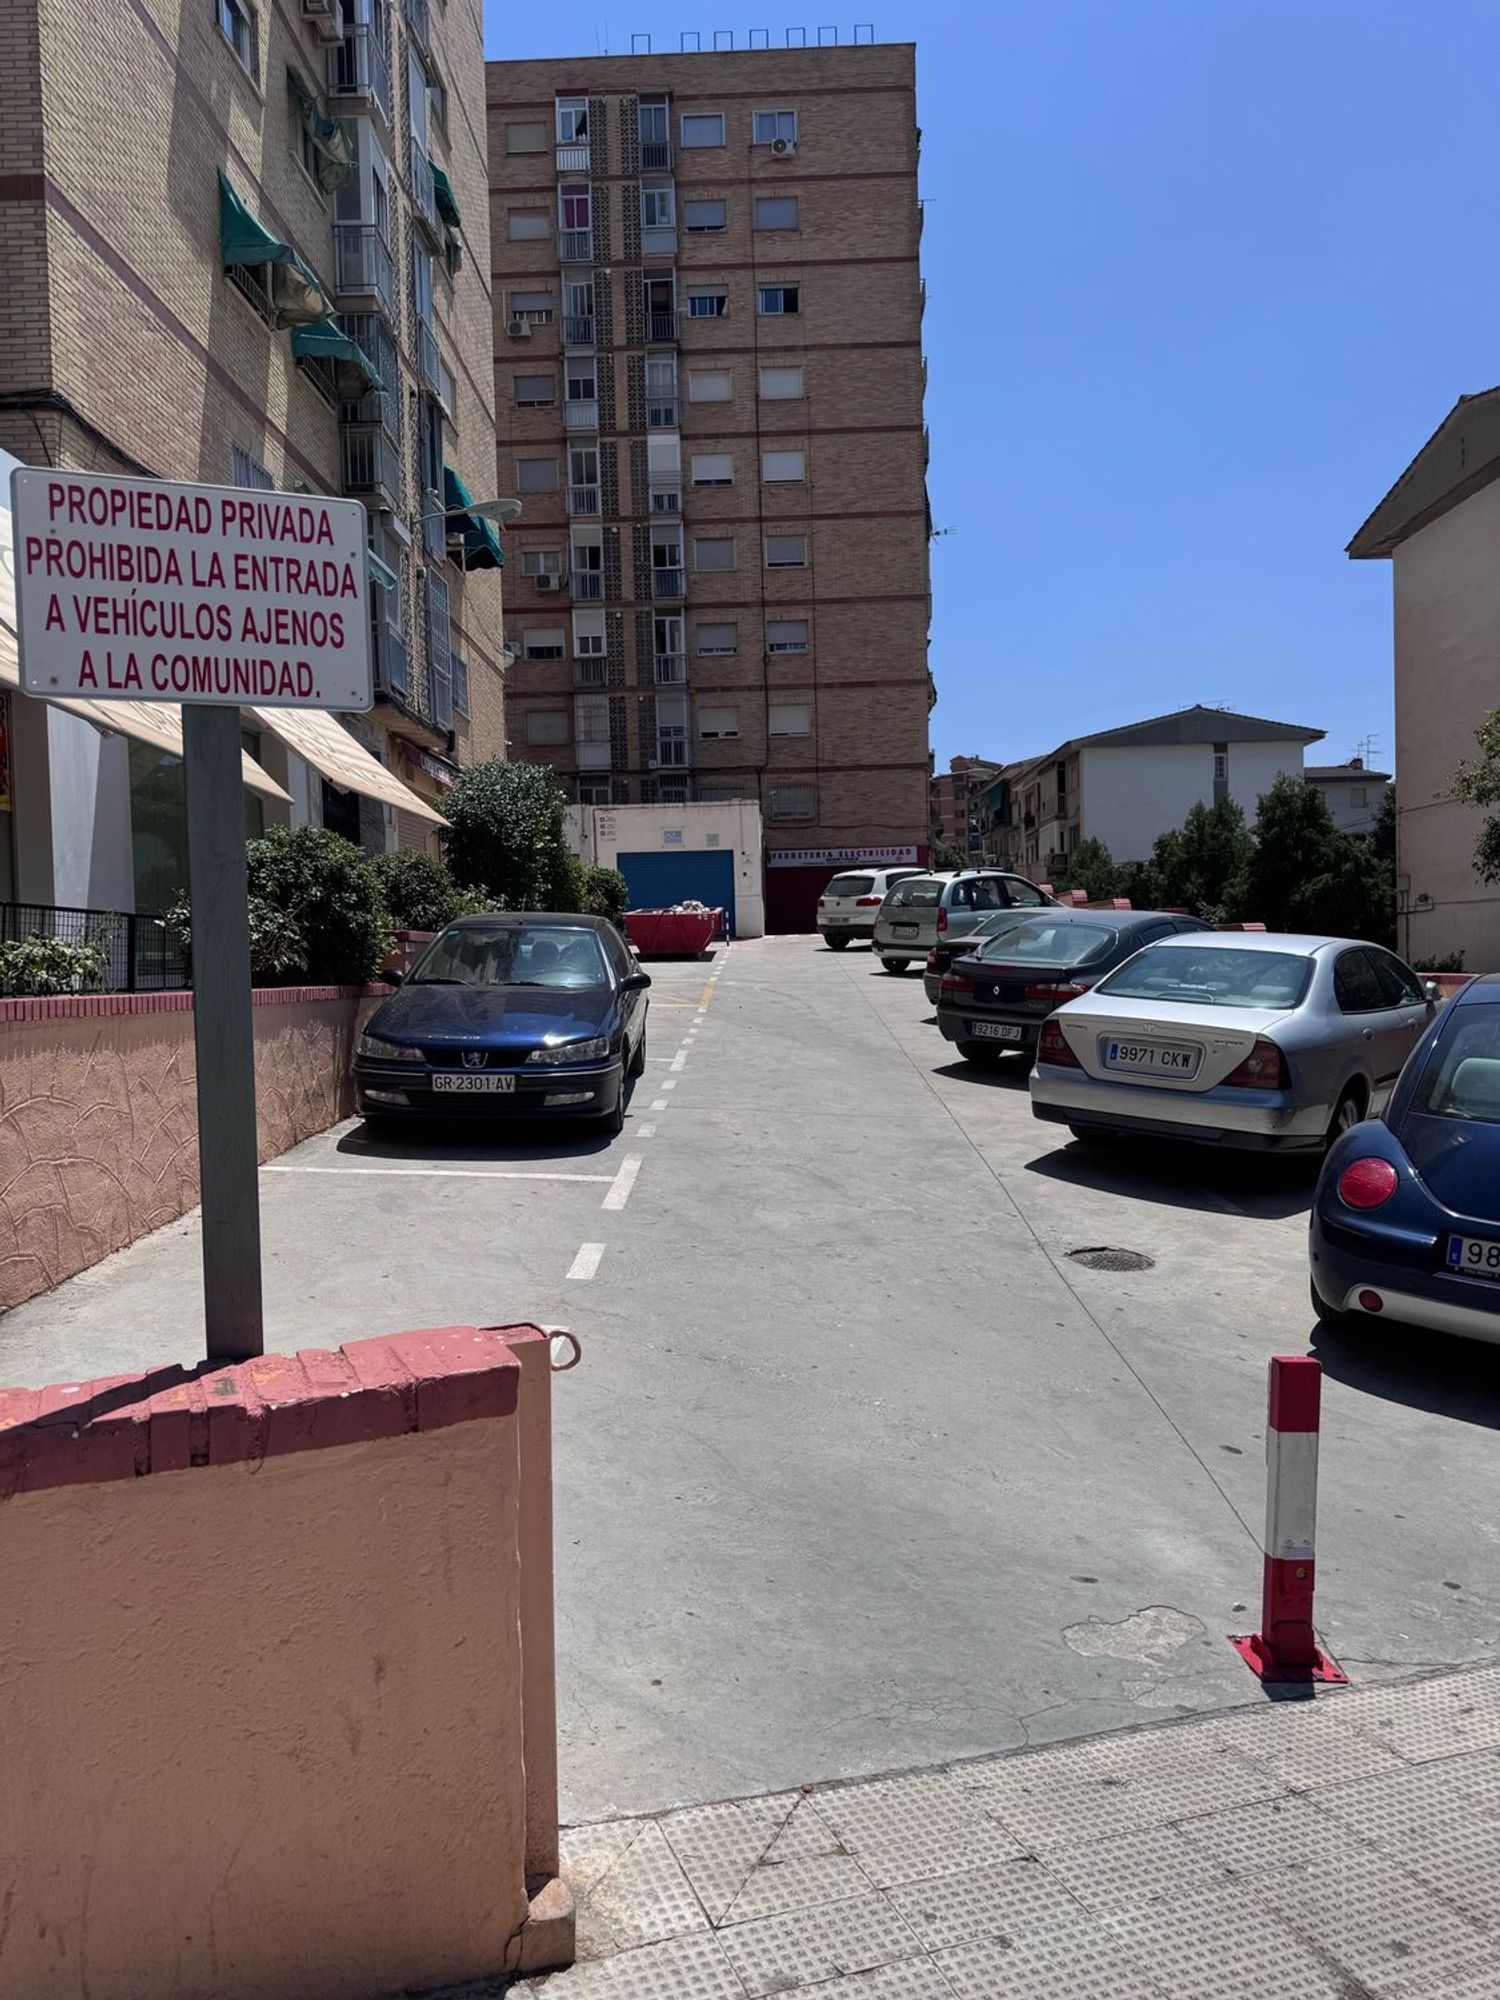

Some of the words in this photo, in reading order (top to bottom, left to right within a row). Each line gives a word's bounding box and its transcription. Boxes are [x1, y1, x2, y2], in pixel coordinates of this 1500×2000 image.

[48, 483, 212, 535] PROPIEDAD
[222, 499, 334, 546] PRIVADA
[26, 537, 182, 586] PROHIBIDA
[191, 550, 226, 589] LA
[234, 553, 358, 599] ENTRADA
[45, 593, 66, 632] A
[73, 588, 232, 642] VEHÍCULOS
[241, 606, 345, 649] AJENOS
[78, 651, 98, 688] A
[107, 652, 143, 690] LA
[151, 654, 321, 699] COMUNIDAD.
[839, 848, 911, 859] ELECTRICIDAD
[1119, 1046, 1154, 1063] 9971
[1161, 1051, 1191, 1068] CKW
